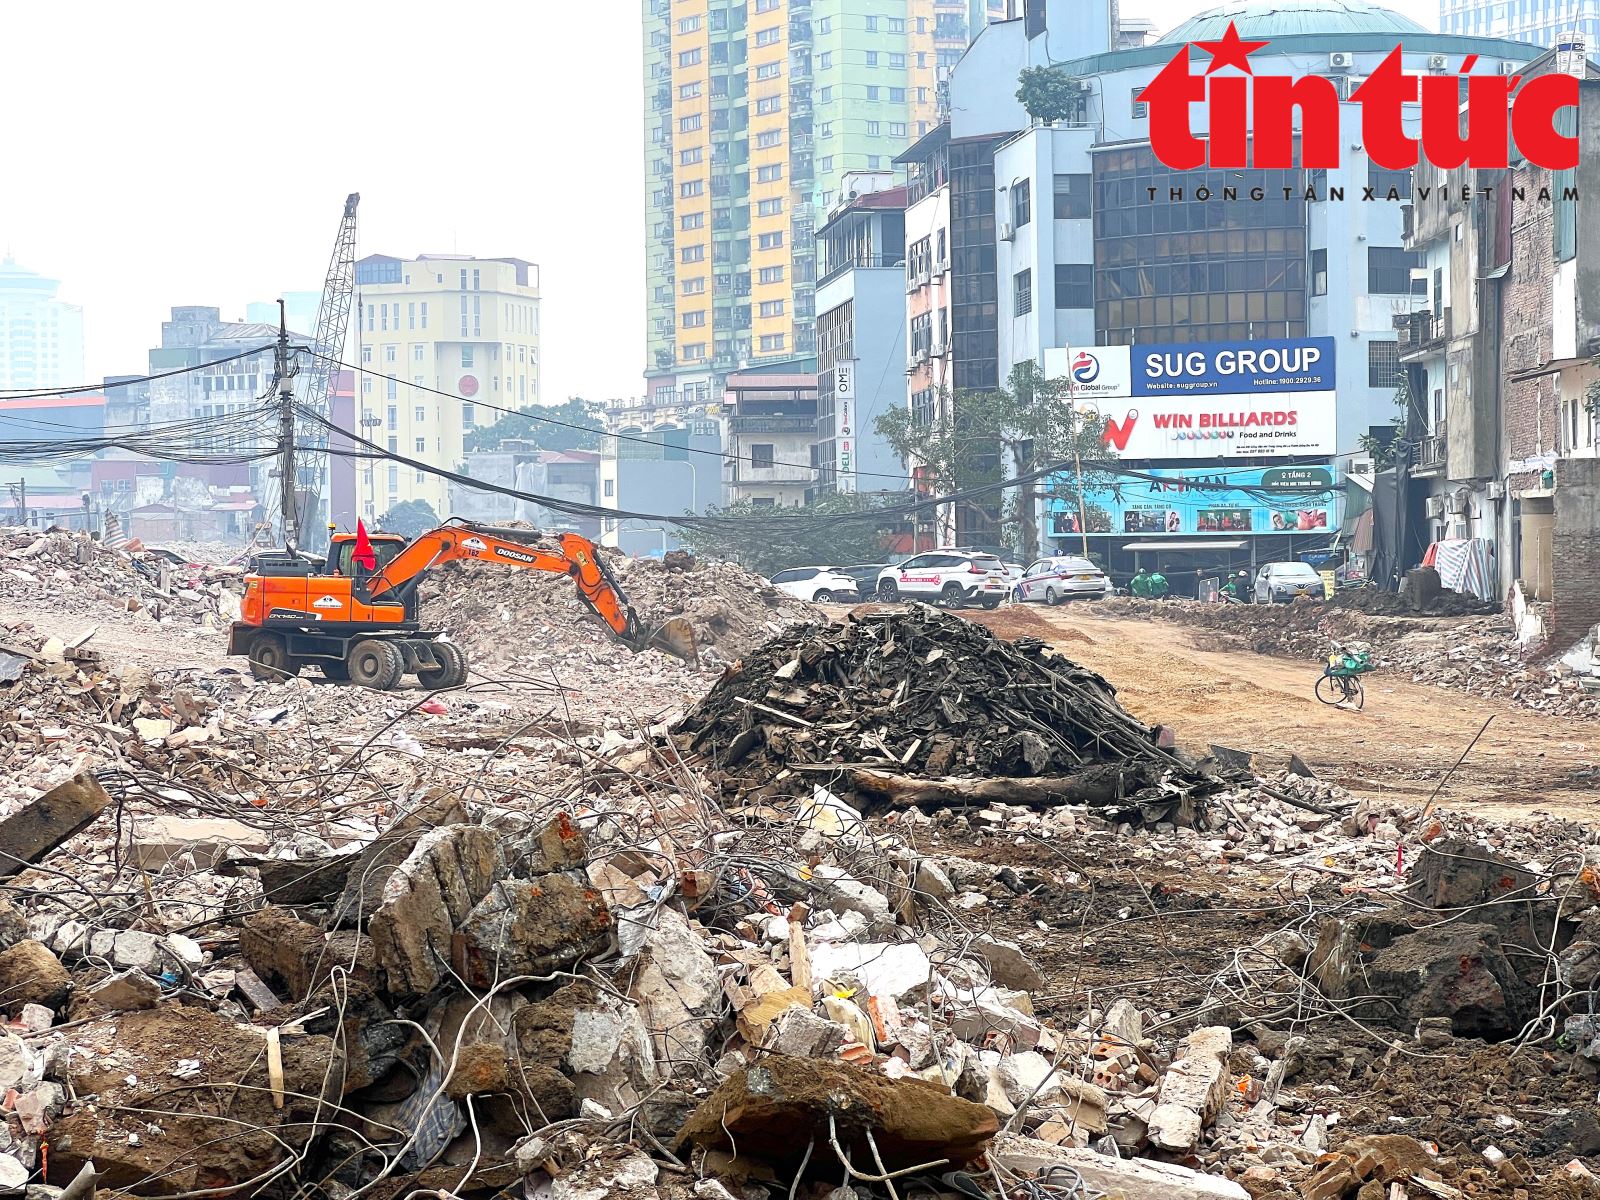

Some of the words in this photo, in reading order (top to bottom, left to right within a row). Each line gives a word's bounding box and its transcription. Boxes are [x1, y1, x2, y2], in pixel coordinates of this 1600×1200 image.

[1145, 351, 1206, 378] SUG
[1214, 347, 1321, 376] GROUP
[1146, 382, 1176, 390] Website:
[1253, 377, 1279, 386] Hotline:
[1101, 384, 1118, 392] Group
[1153, 413, 1193, 429] WIN
[1199, 410, 1298, 429] BILLIARDS
[1239, 431, 1258, 439] Food
[1274, 430, 1297, 438] Drinks
[497, 547, 534, 563] DOOSAN
